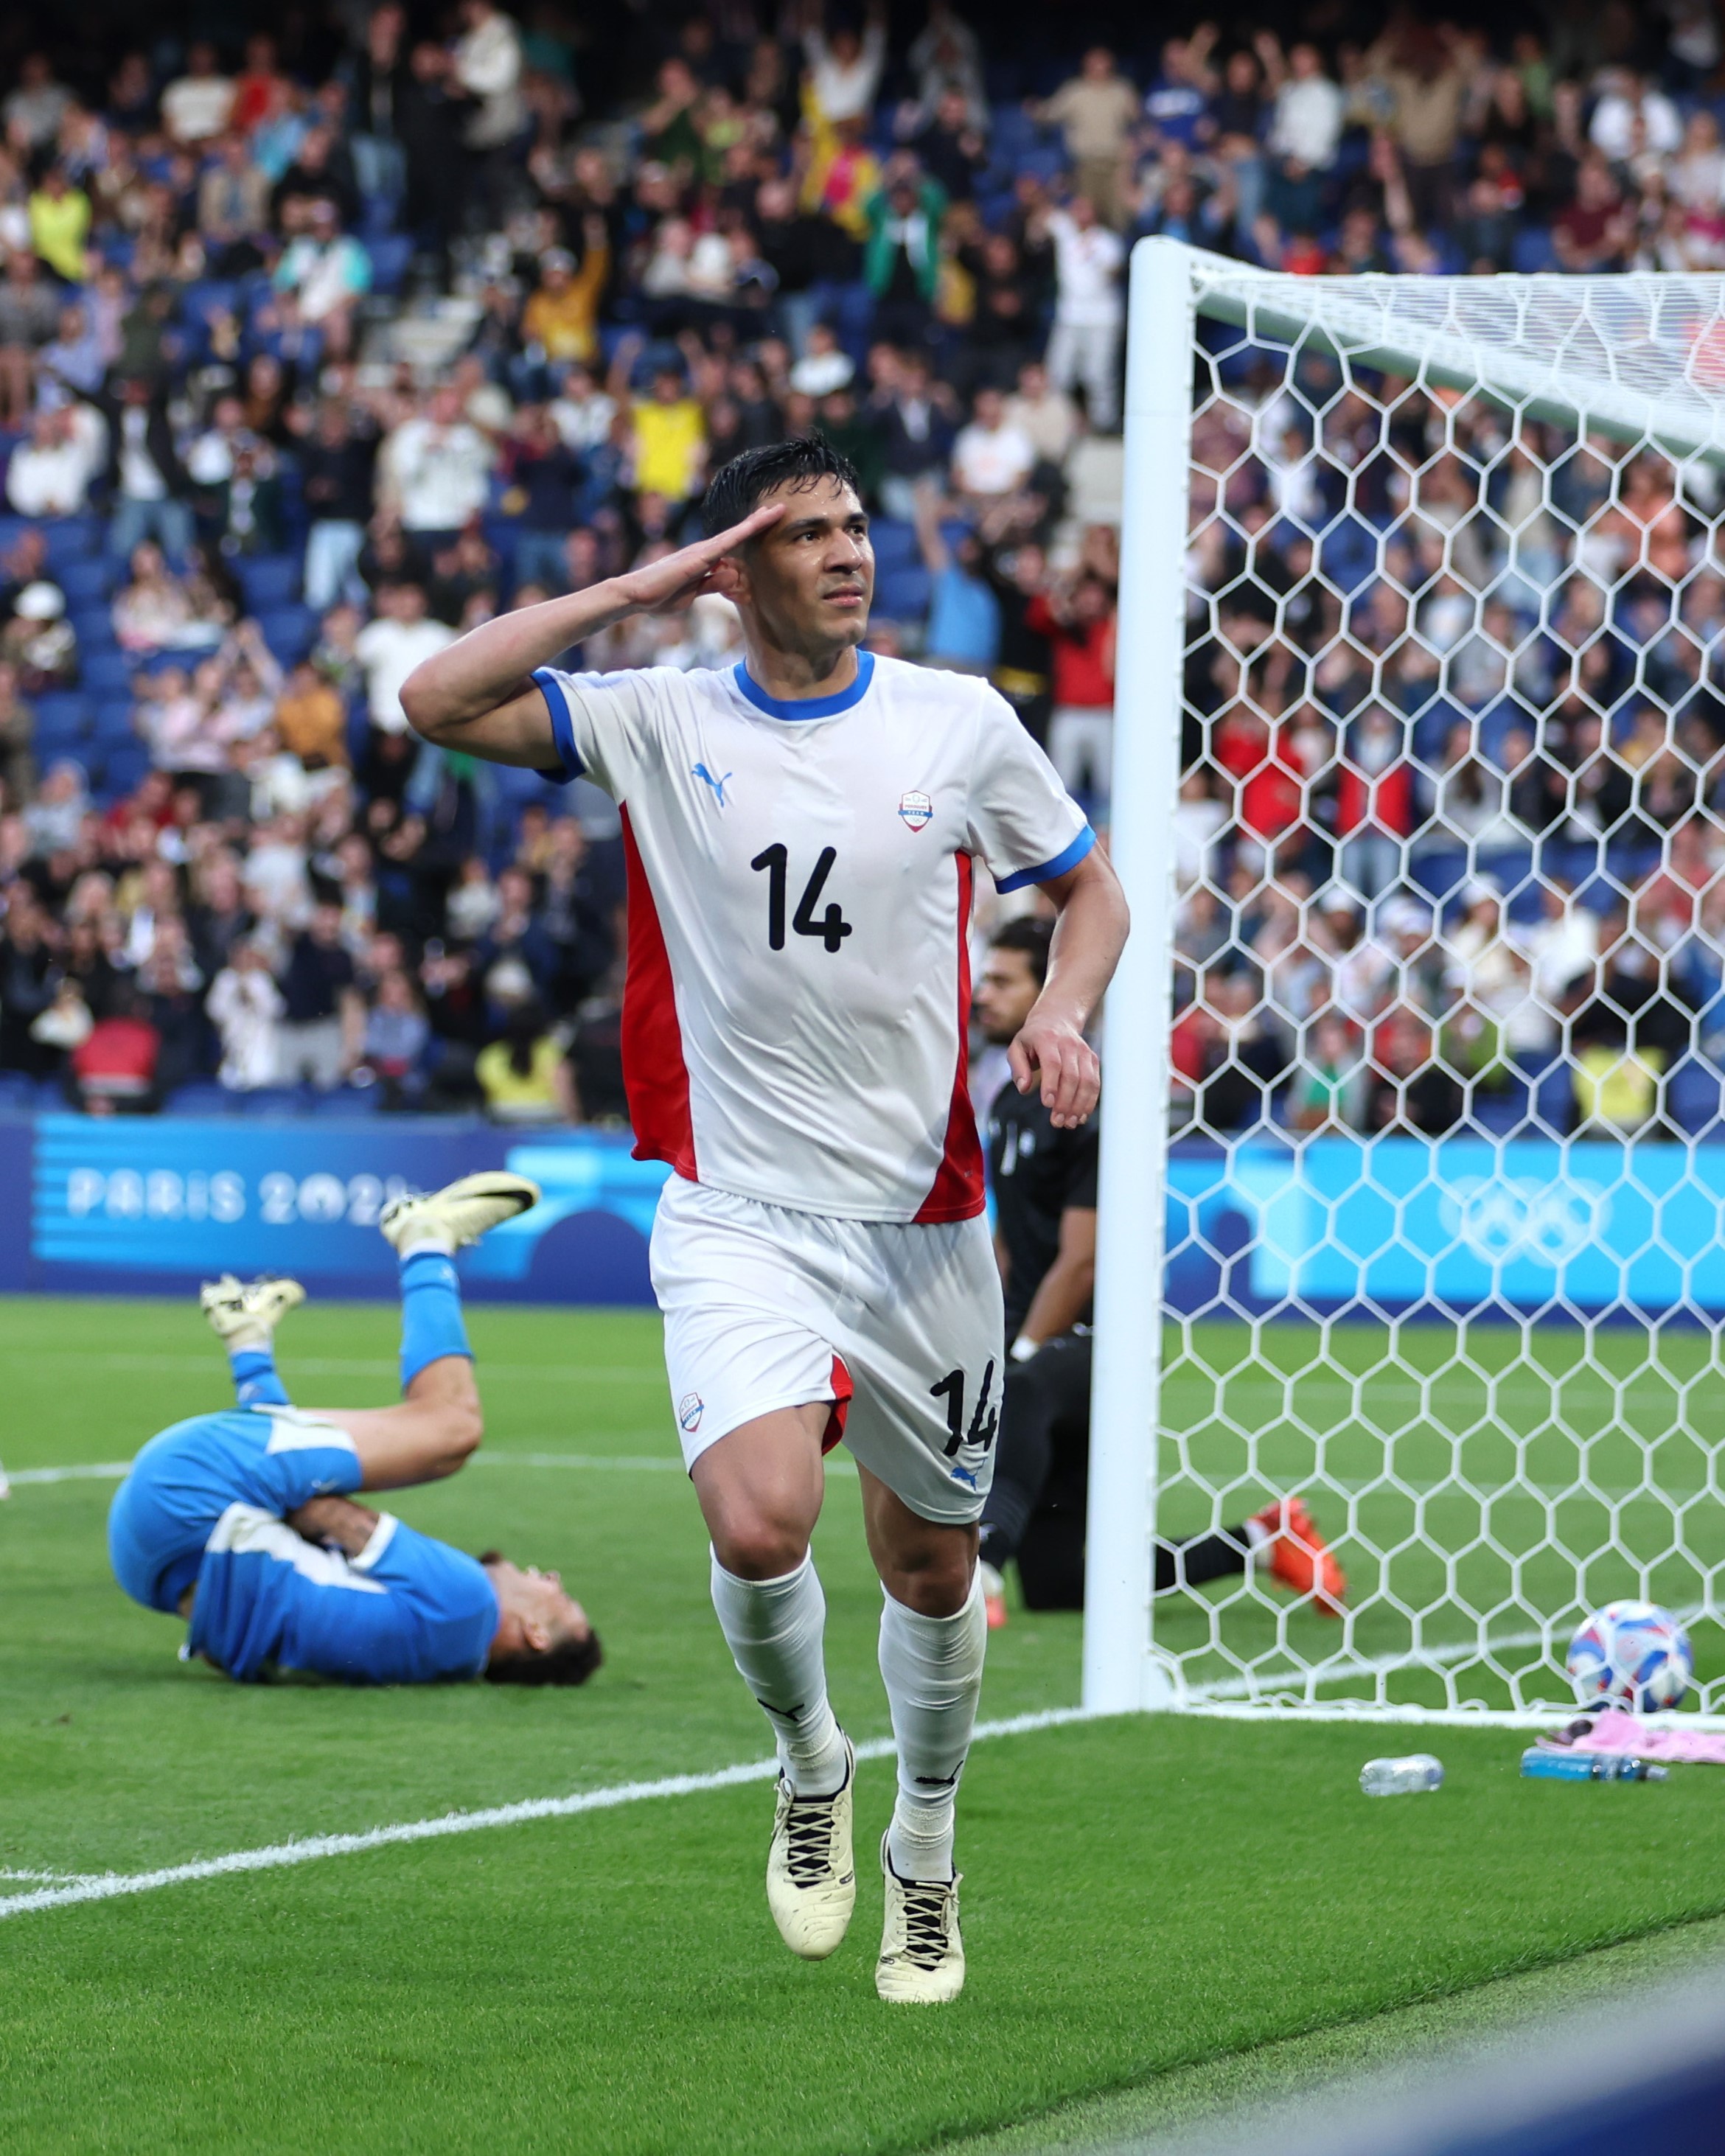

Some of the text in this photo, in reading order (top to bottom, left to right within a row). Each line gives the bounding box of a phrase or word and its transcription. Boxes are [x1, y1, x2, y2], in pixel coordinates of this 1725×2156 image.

[750, 842, 852, 952] 14
[68, 1167, 246, 1223] PARIS
[930, 1359, 997, 1456] 14
